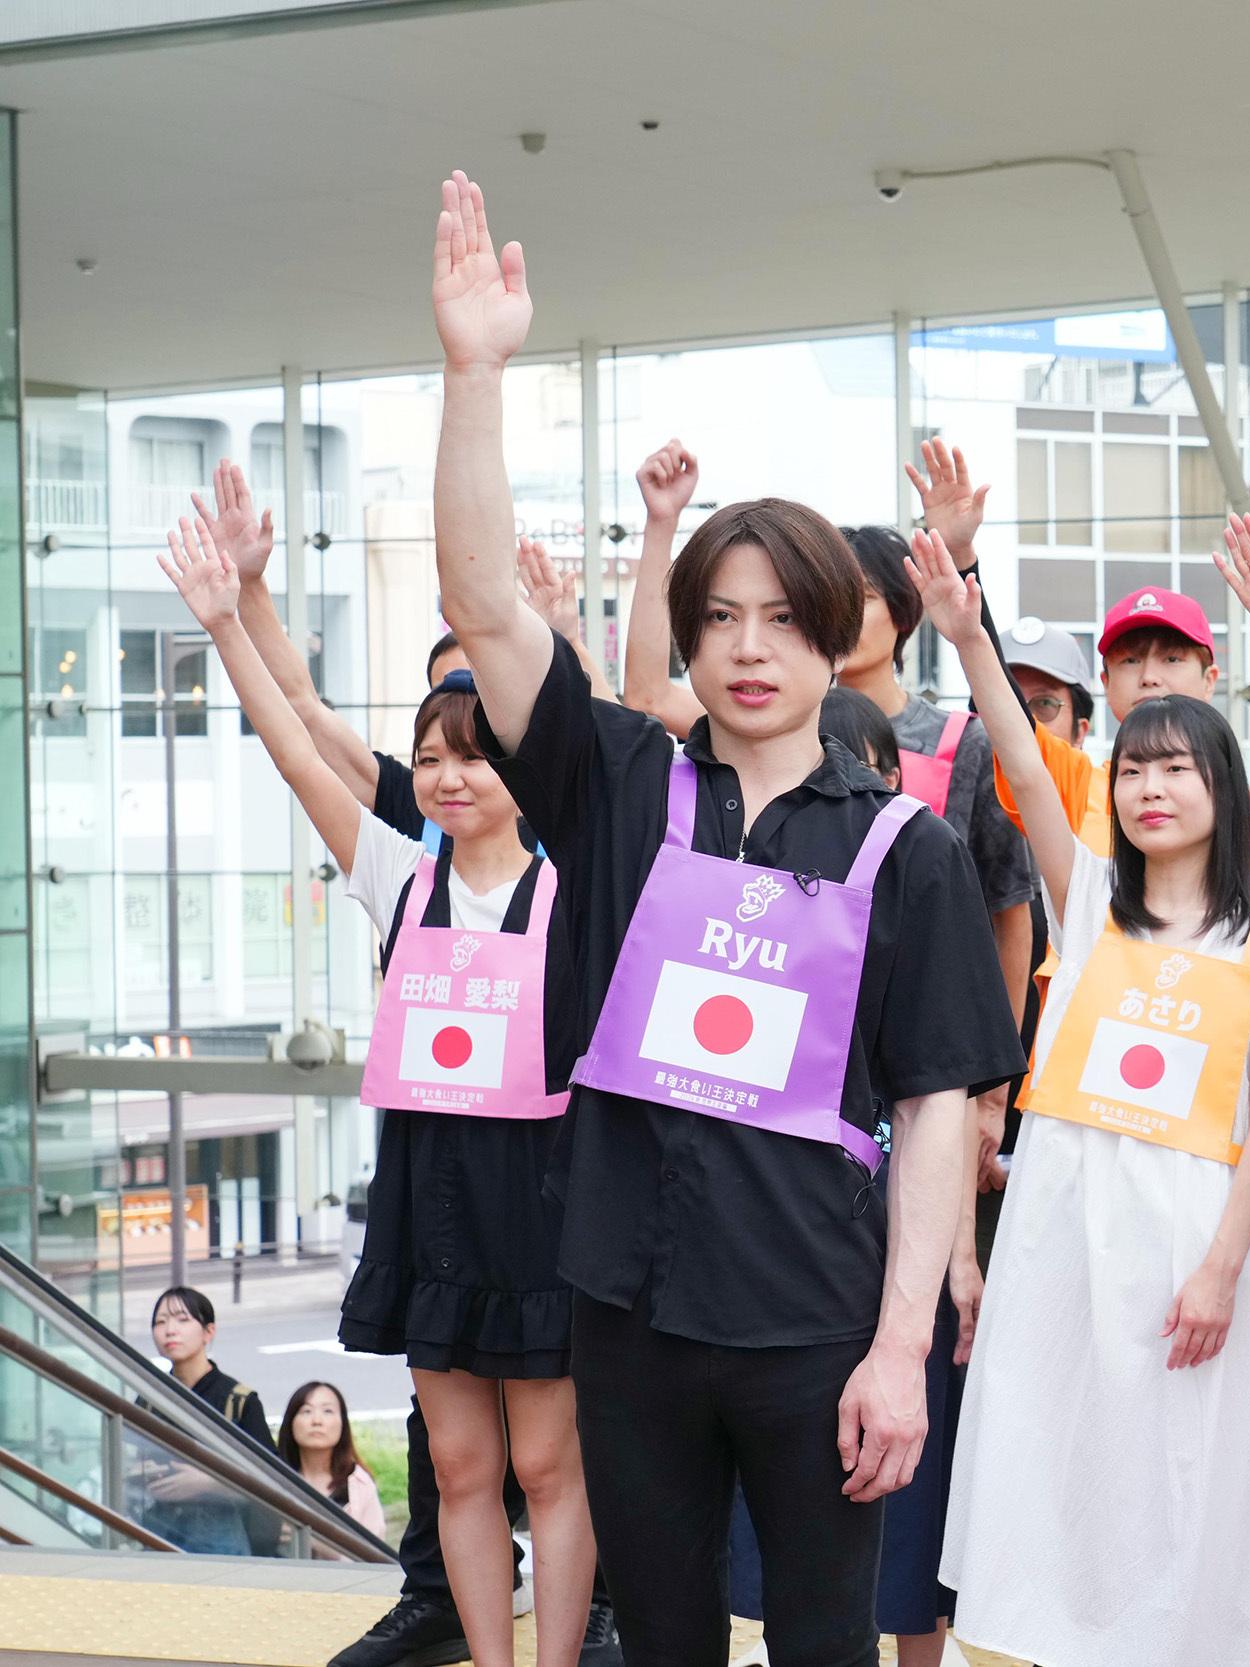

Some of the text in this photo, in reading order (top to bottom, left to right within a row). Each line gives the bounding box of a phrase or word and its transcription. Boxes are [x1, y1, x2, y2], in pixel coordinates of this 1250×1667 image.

[697, 917, 789, 972] Ryu
[400, 973, 520, 1010] 田畑 愛梨
[1119, 987, 1202, 1031] あさり
[655, 1071, 759, 1108] 最強大食い王決定戦
